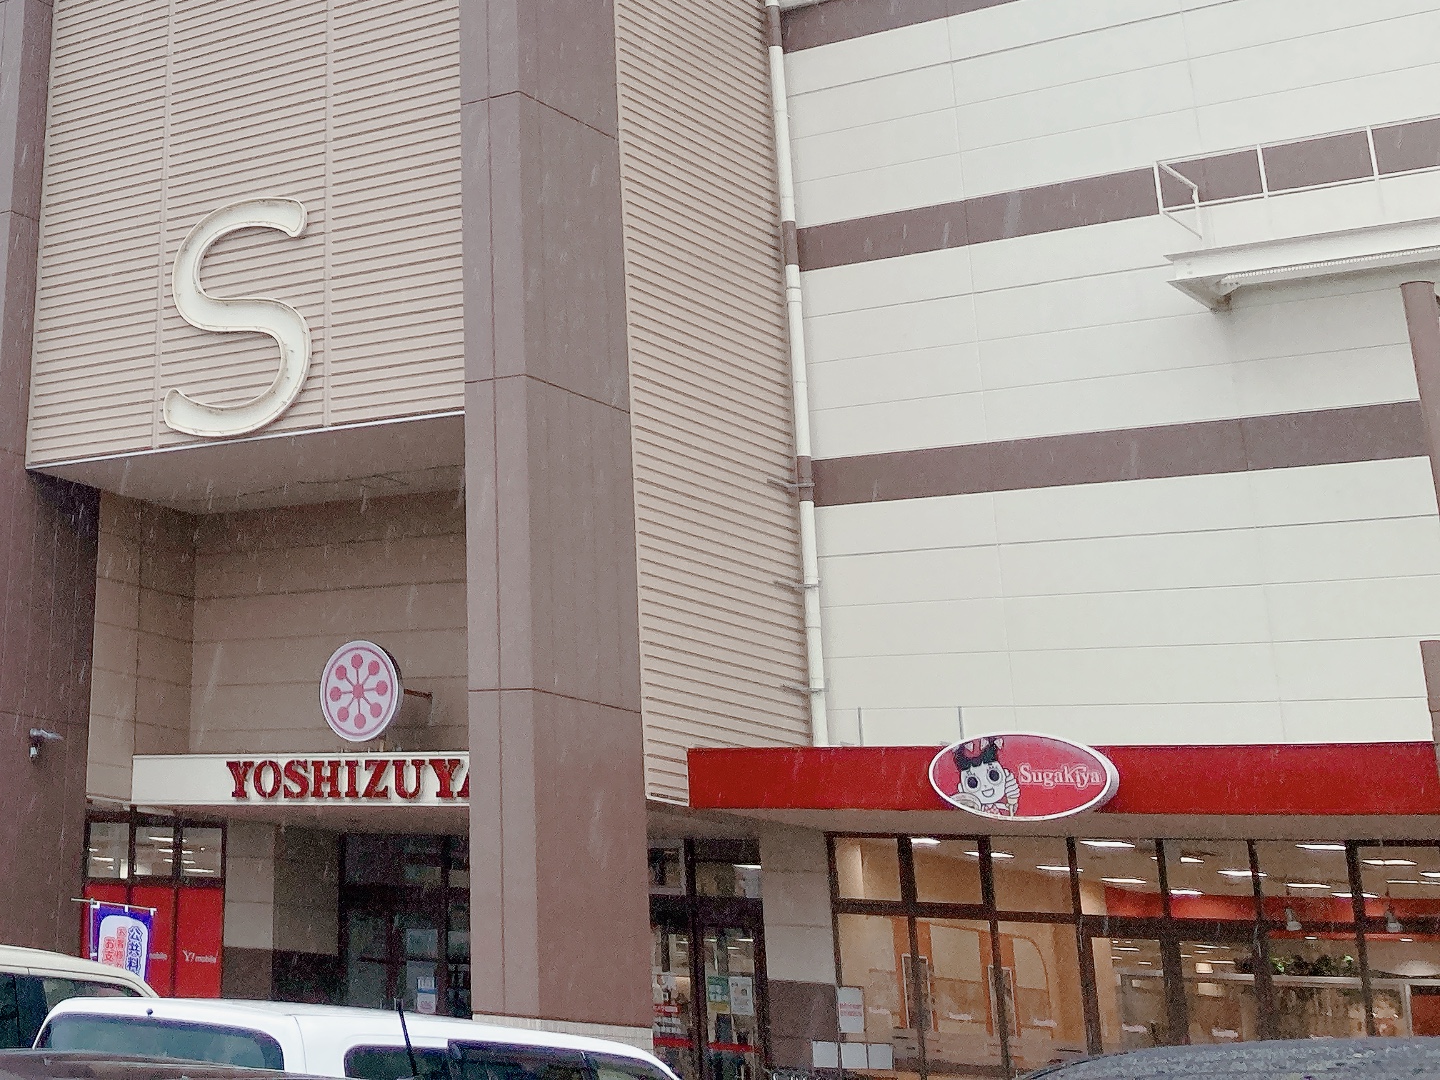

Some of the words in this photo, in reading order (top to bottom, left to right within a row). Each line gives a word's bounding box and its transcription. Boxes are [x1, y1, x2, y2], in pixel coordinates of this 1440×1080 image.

[163, 197, 312, 437] S
[1019, 763, 1102, 789] Sugakiya
[126, 925, 143, 975] 公共料
